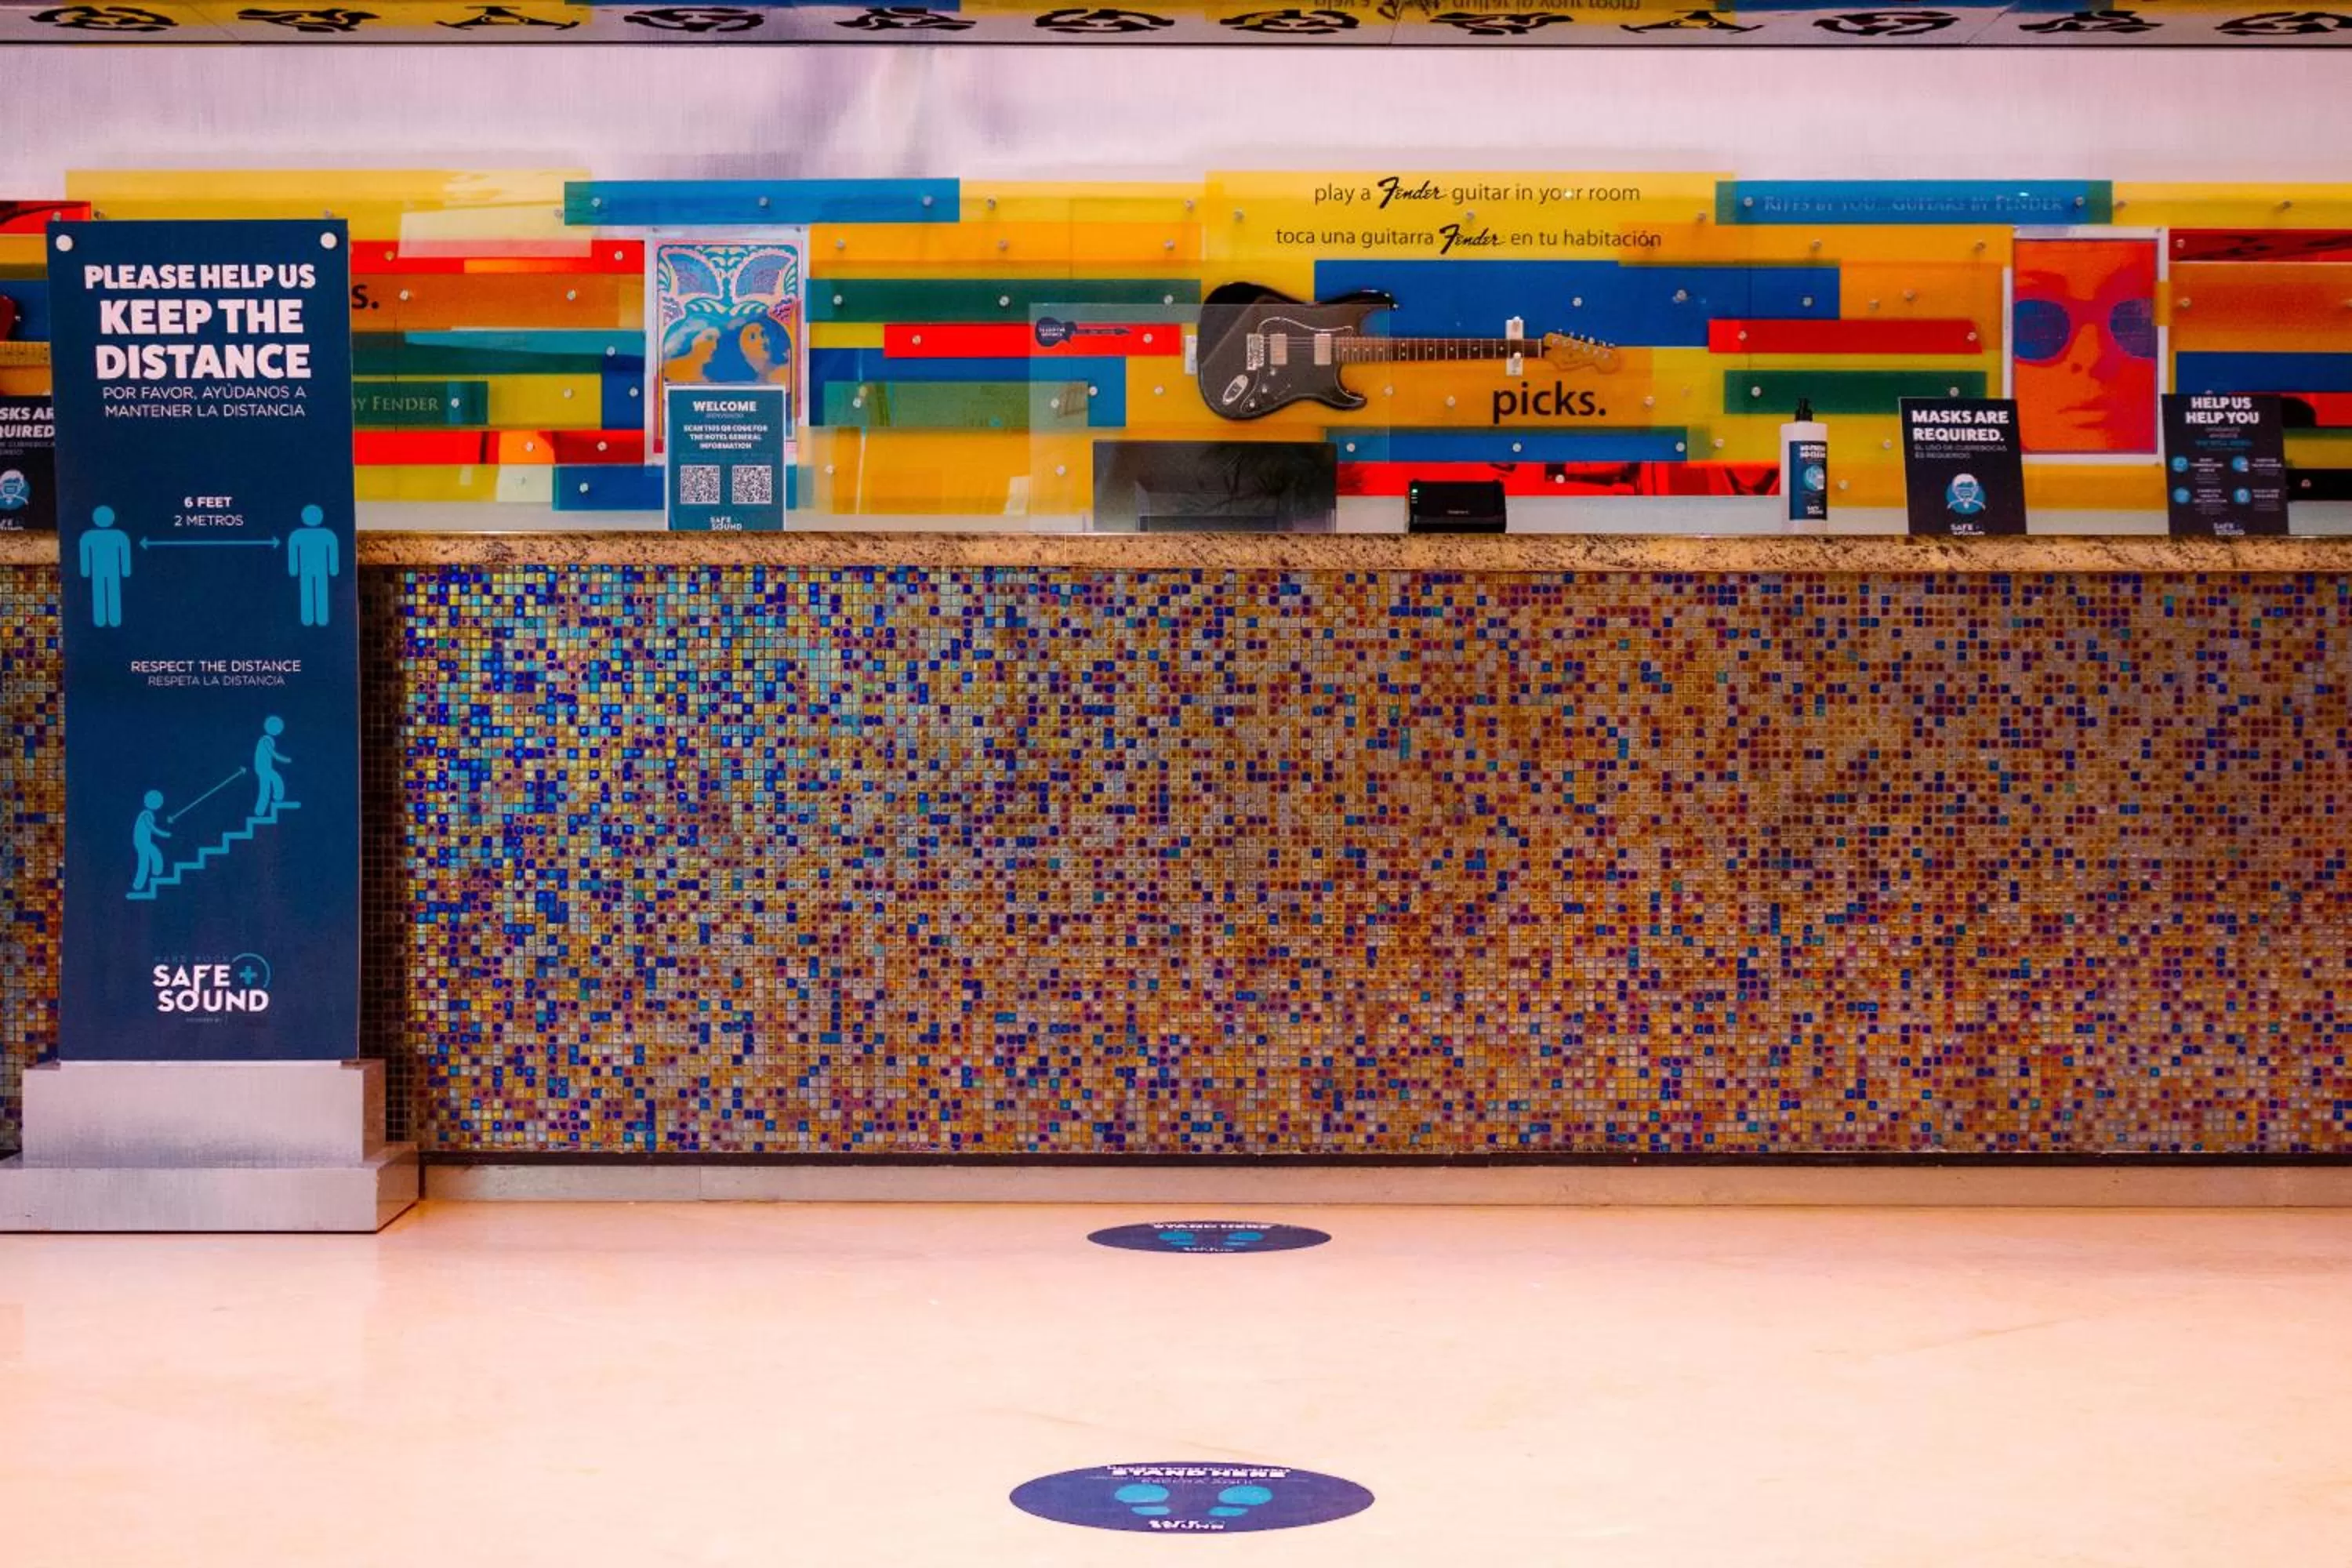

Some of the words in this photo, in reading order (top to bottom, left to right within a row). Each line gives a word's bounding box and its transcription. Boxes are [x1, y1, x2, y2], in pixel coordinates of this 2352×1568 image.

[1315, 183, 1356, 205] play
[1361, 187, 1370, 201] a
[1377, 176, 1447, 209] Fender
[1453, 183, 1510, 205] guitar
[1516, 183, 1533, 201] in
[1589, 187, 1641, 201] room
[1276, 228, 1315, 245] toca
[1321, 231, 1356, 245] una
[1361, 228, 1434, 249] guitarra
[1439, 223, 1505, 255] Fender
[1511, 232, 1533, 245] en
[1539, 232, 1558, 245] tu
[1563, 229, 1661, 246] habitación
[84, 264, 195, 289] PLEASE
[200, 264, 274, 289] HELP
[278, 264, 316, 289] US
[100, 299, 212, 334] KEEP
[217, 299, 303, 333] THE
[96, 343, 311, 379] DISTANCE
[103, 386, 136, 399] POR
[142, 386, 198, 401] FAVOR,
[294, 386, 306, 399] A
[372, 395, 440, 411] FENDER
[693, 401, 757, 412] WELCOME
[1493, 381, 1607, 424] picks.
[2190, 397, 2230, 409] HELP
[2230, 397, 2252, 409] US
[0, 407, 31, 420] SKS
[32, 407, 54, 420] AR
[105, 405, 192, 417] MANTENER
[197, 405, 219, 417] LA
[223, 404, 305, 417] DISTANCIA
[1911, 410, 1972, 423] MASKS
[1974, 410, 2009, 423] ARE
[2185, 412, 2225, 424] HELP
[2225, 412, 2259, 424] YOU
[0, 424, 56, 438] UIRED
[1913, 428, 2005, 441] REQUIRED.
[184, 497, 193, 508] 6
[198, 497, 232, 508] FEET
[174, 515, 183, 526] 2
[187, 515, 244, 526] METROS
[131, 661, 194, 672] RESPECT
[199, 660, 227, 672] THE
[231, 660, 301, 672] DISTANCE
[148, 676, 200, 686] RESPETA
[204, 676, 220, 686] LA
[223, 675, 285, 686] DISTANCIA
[152, 964, 230, 991] SAFE
[157, 989, 269, 1012] SOUND
